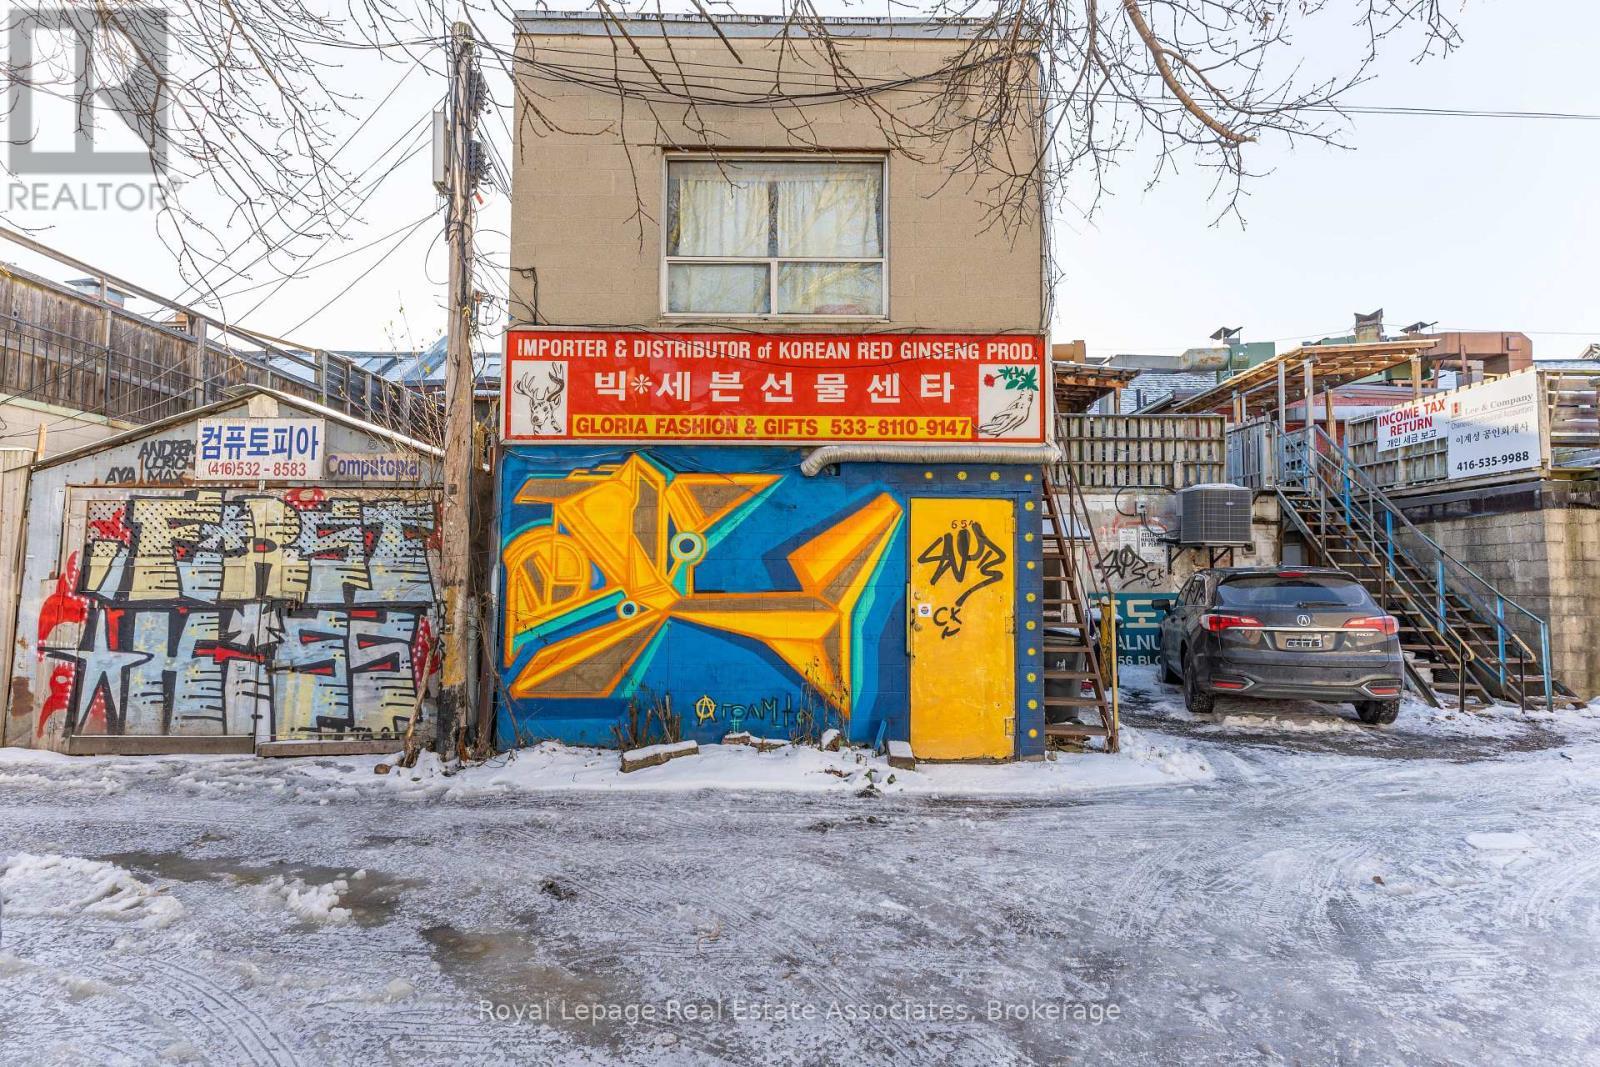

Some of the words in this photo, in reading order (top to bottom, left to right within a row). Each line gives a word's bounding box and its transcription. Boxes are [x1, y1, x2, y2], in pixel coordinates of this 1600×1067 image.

[517, 338, 607, 358] IMPORTER
[614, 338, 628, 358] &
[633, 339, 750, 359] DISTRIBUTOR
[757, 342, 772, 359] of
[779, 341, 849, 360] KOREAN
[857, 342, 893, 360] RED
[900, 342, 979, 360] GINSENG
[986, 342, 1038, 361] PROD.
[1490, 393, 1534, 408] Company
[1379, 406, 1420, 427] INCOME
[1424, 399, 1446, 415] TAX
[575, 416, 649, 435] GLORIA
[655, 416, 738, 435] FASHION
[744, 418, 757, 435] &
[763, 418, 819, 436] GIFTS
[1390, 416, 1433, 436] RETURN
[202, 424, 319, 461] 컴퓨토피아
[1387, 437, 1401, 448] 개인
[1403, 433, 1418, 445] 세금
[1421, 429, 1437, 440] 보고
[273, 462, 307, 477] 8583
[1457, 450, 1529, 472] 416-535-9988
[105, 466, 137, 484] AYA
[1118, 634, 1161, 651] ALNU
